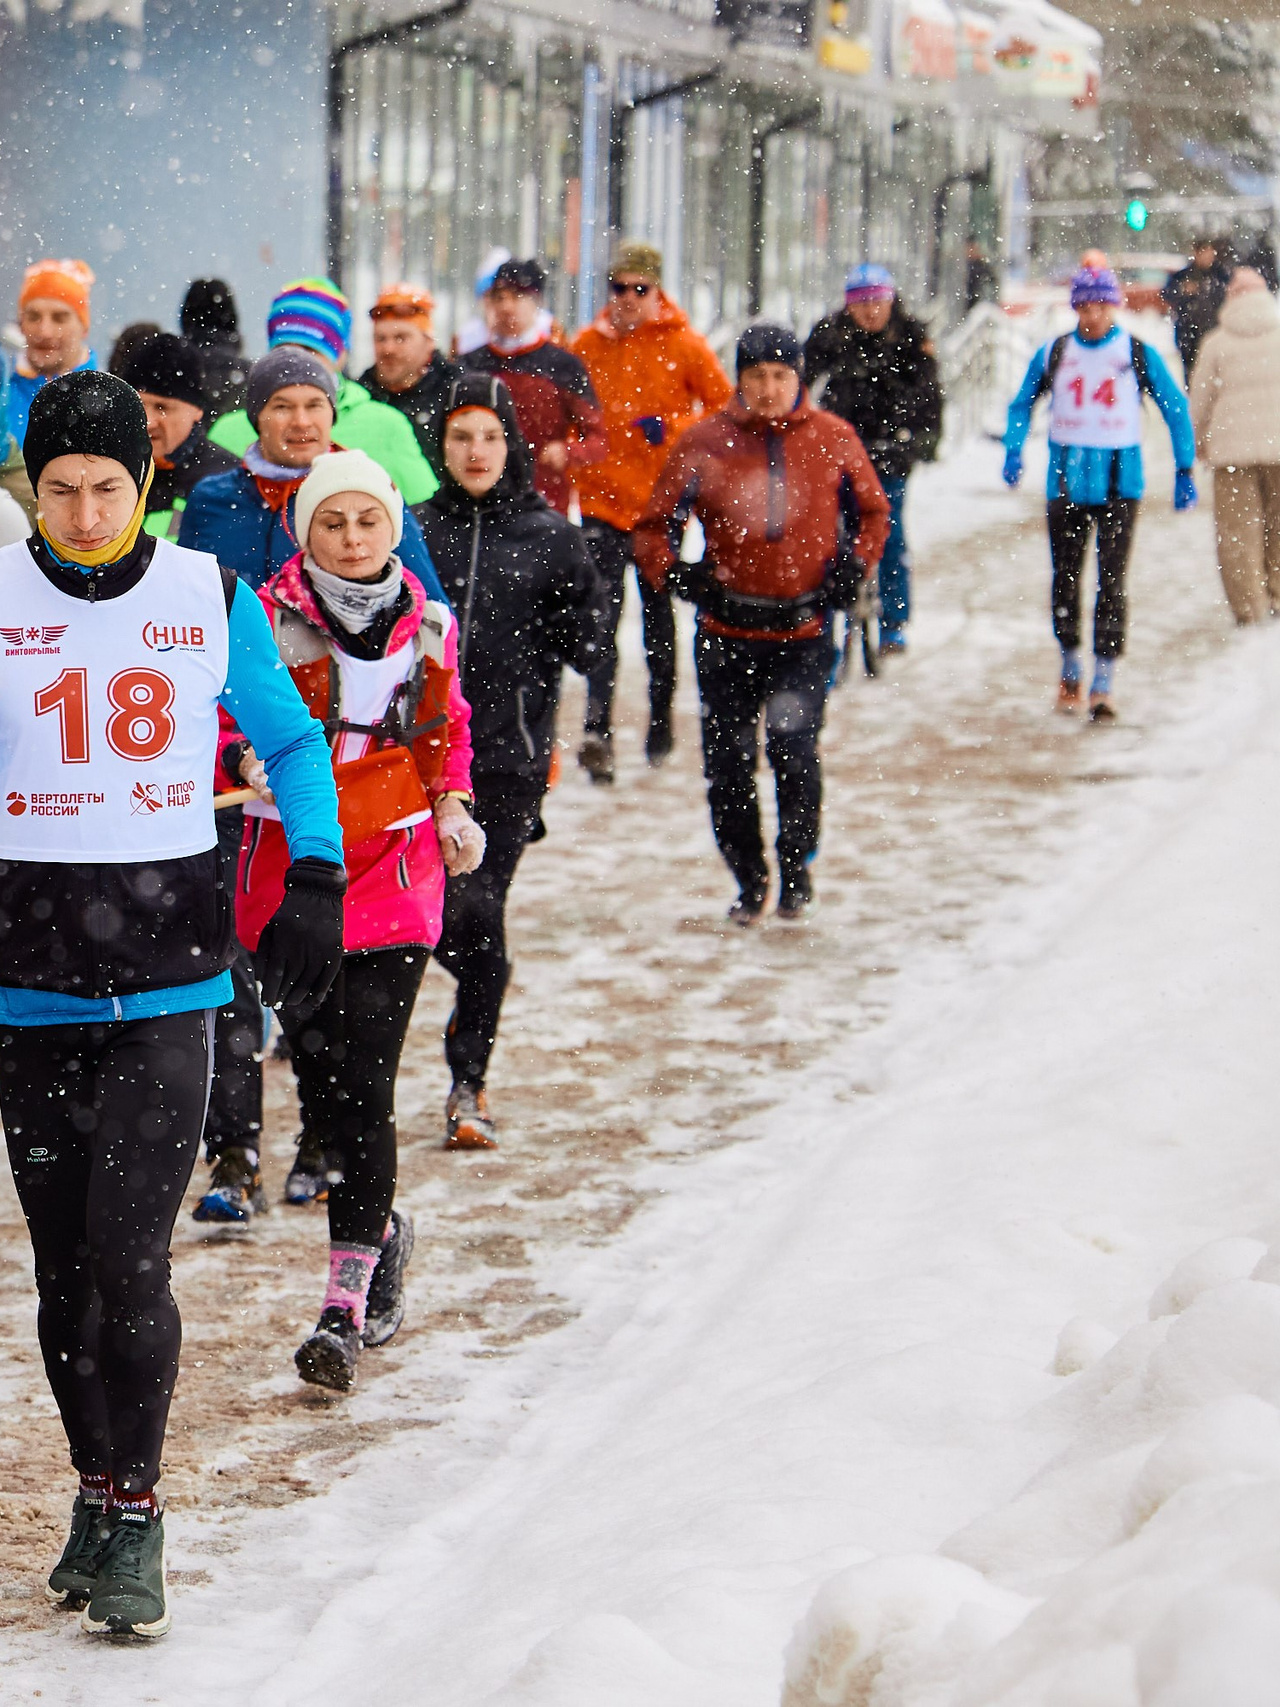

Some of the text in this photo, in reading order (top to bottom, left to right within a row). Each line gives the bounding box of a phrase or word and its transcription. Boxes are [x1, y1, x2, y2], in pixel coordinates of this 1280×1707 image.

[1068, 376, 1115, 408] 14
[152, 626, 204, 646] НЦВ
[5, 647, 61, 657] ВИНТОКРЫЛЫЕ
[34, 666, 175, 764] 18
[167, 780, 195, 795] ППОО
[31, 792, 104, 804] ВЕРТОЛЕТЫ
[167, 794, 191, 808] НЦВ
[31, 804, 79, 816] РОССИИ
